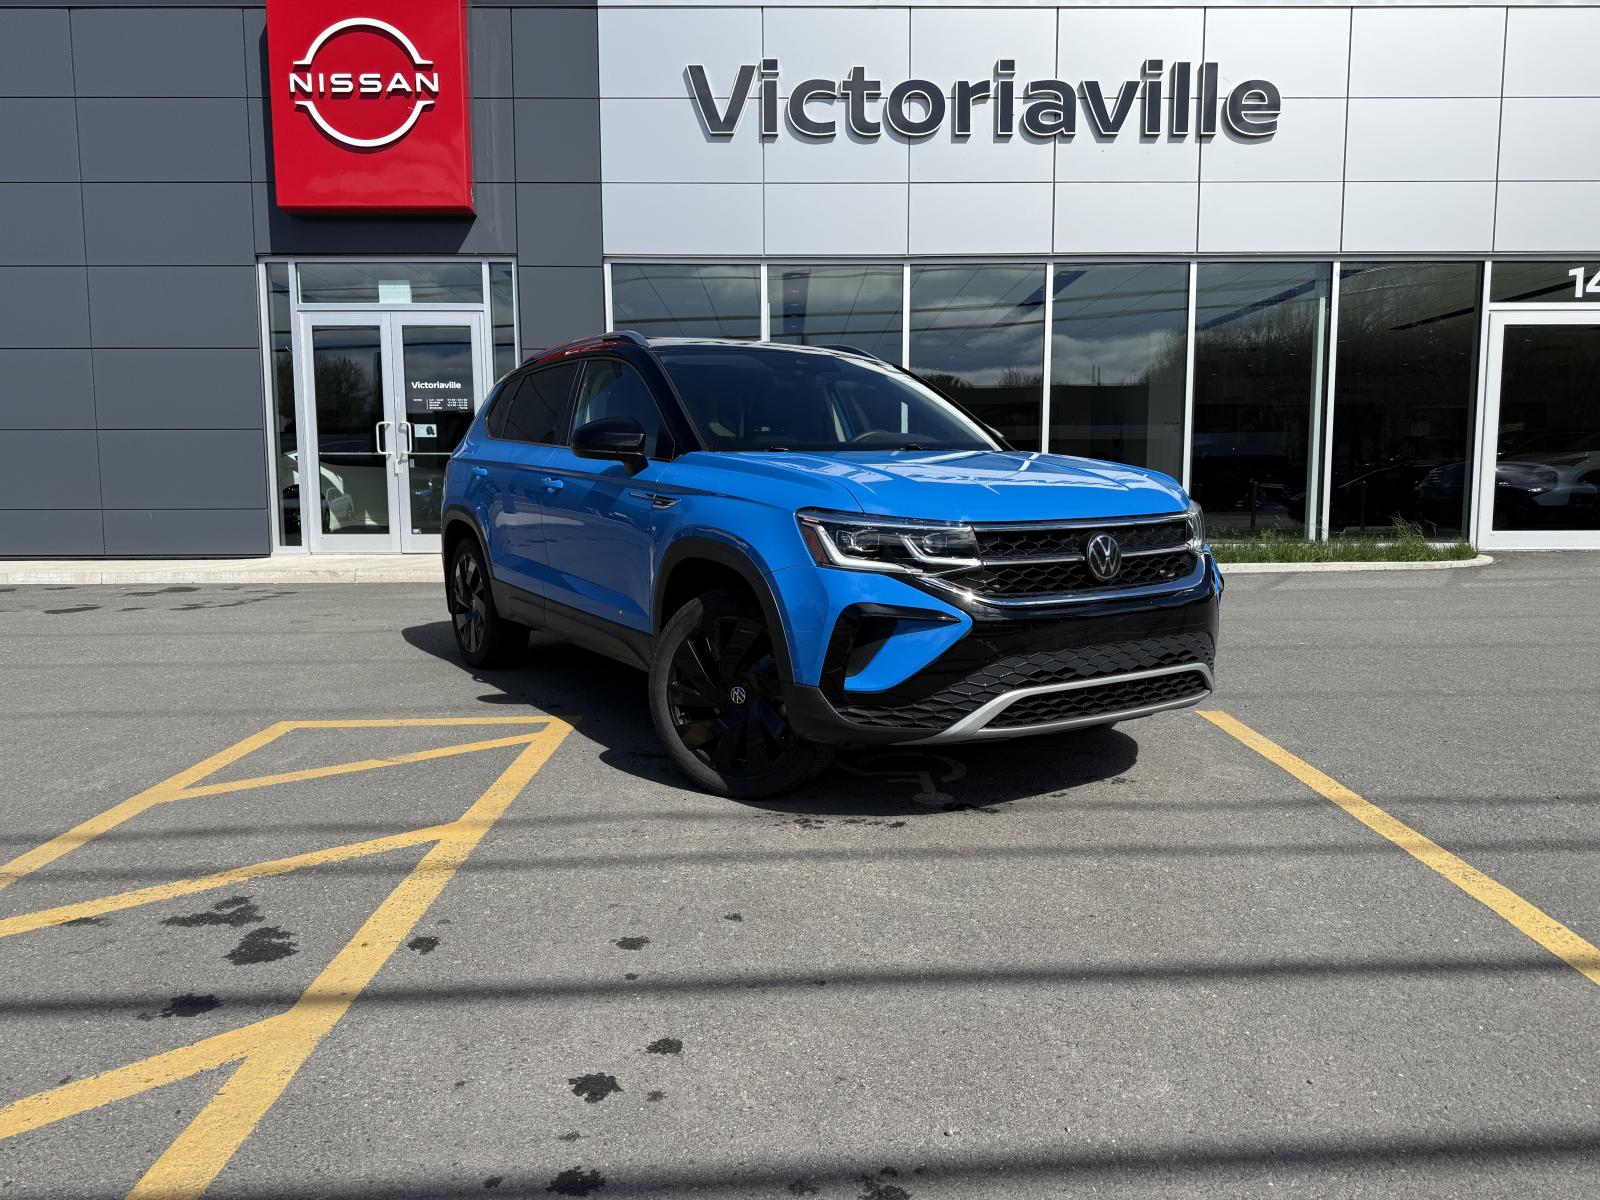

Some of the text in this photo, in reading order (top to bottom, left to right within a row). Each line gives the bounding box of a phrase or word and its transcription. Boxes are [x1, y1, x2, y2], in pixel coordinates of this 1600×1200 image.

[289, 72, 439, 93] NISSAN
[686, 58, 1281, 137] Victoriaville
[411, 381, 461, 389] Victoriaville
